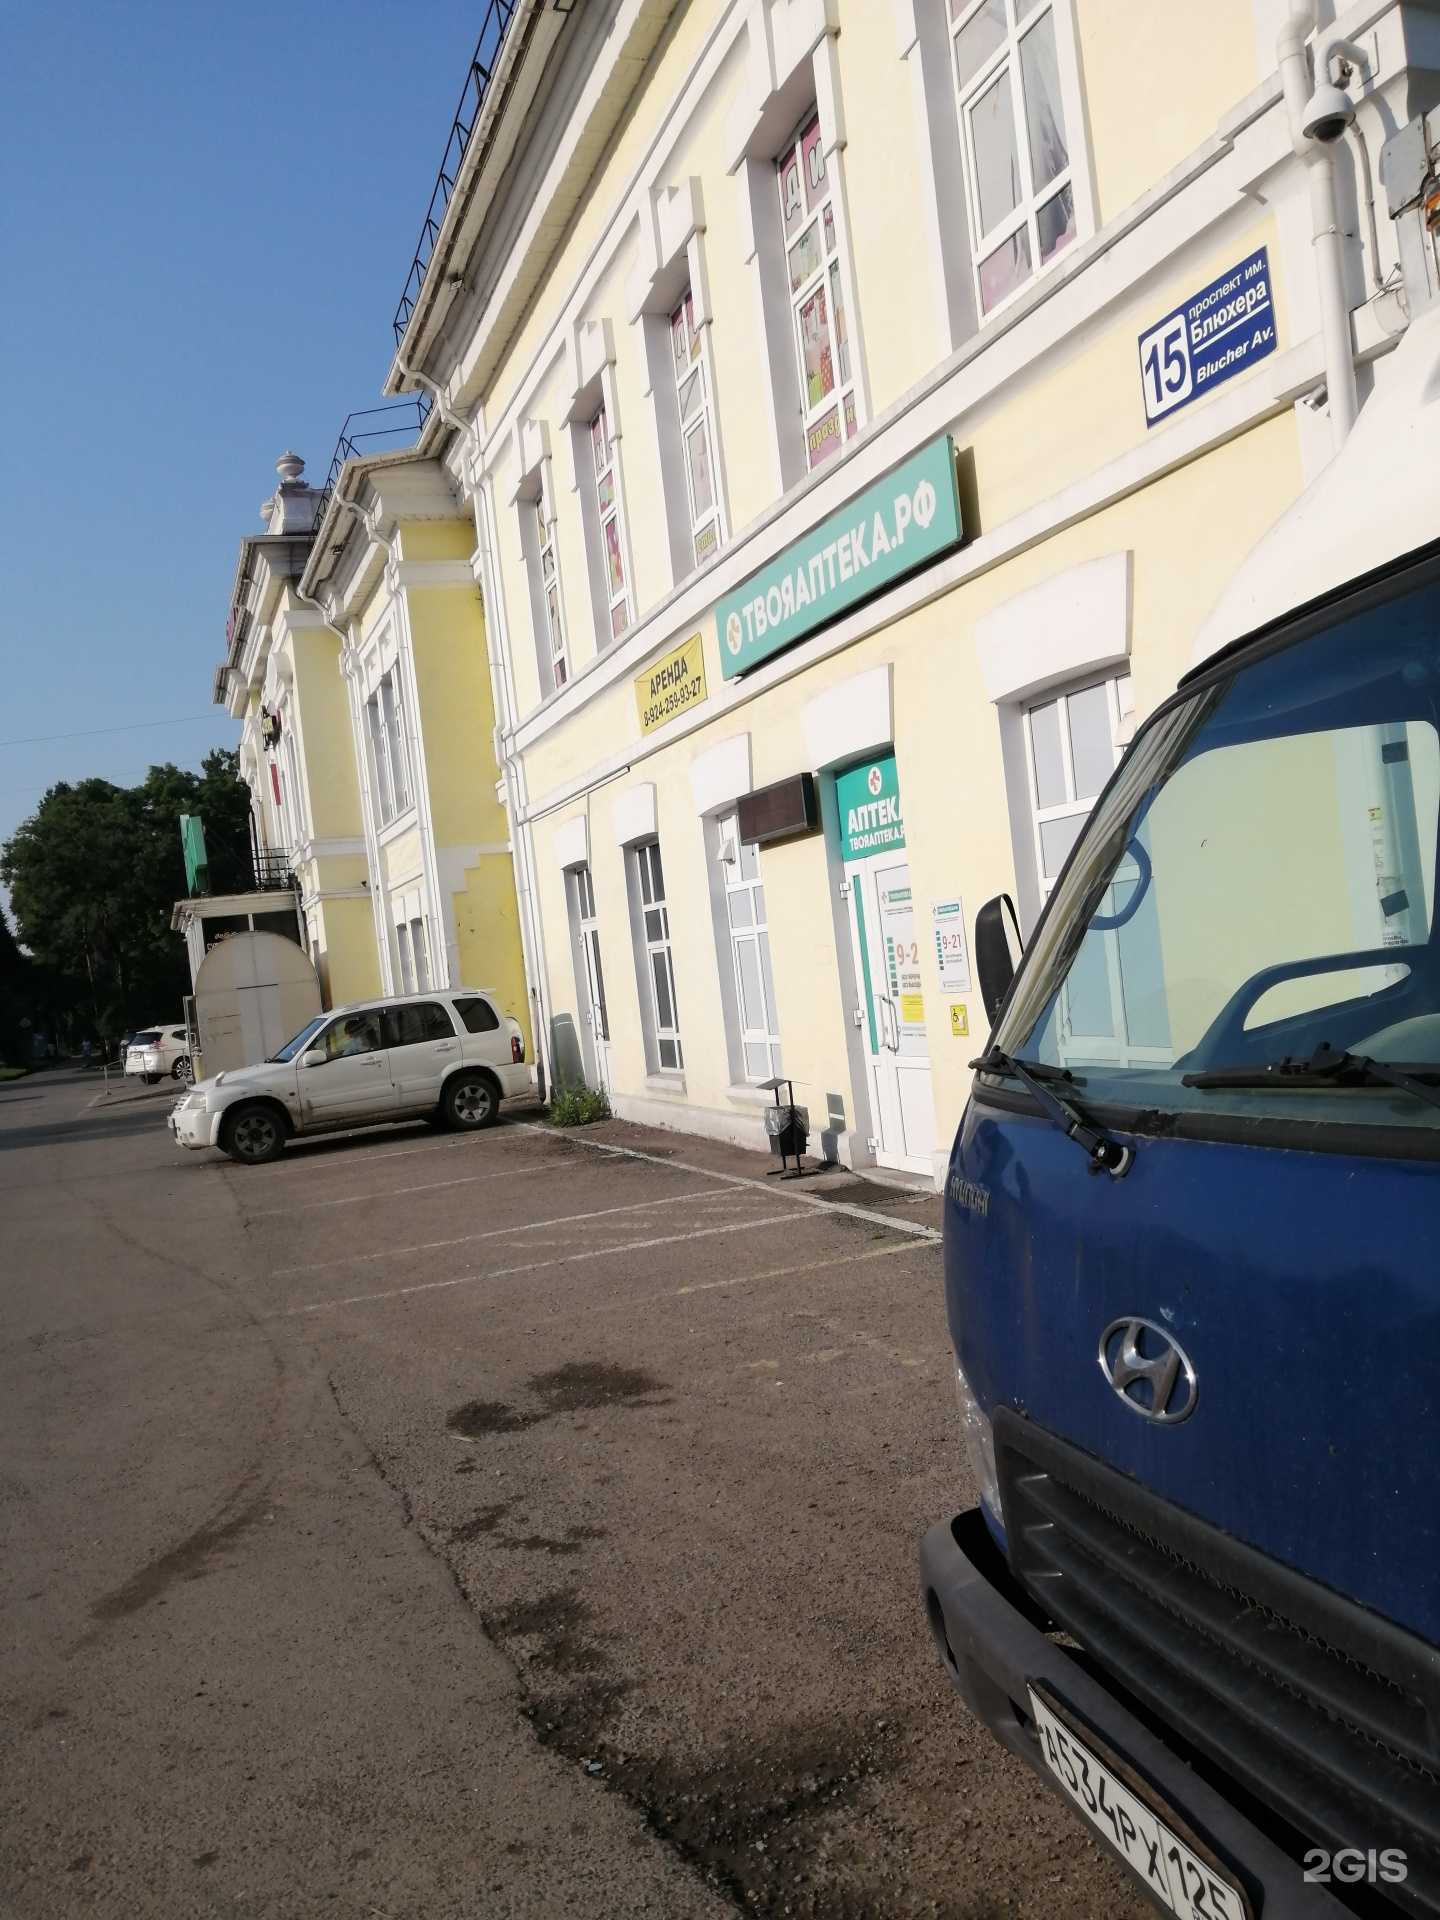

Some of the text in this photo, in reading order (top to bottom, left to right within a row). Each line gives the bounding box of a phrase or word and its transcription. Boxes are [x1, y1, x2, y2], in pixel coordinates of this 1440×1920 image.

[1188, 258, 1267, 320] проспект им.
[1190, 280, 1268, 345] Блюхера
[1144, 327, 1187, 404] 15
[1196, 325, 1275, 384] Blucher Av.
[741, 479, 937, 642] ТВОЯАПТЕКА.РФ
[650, 656, 689, 699] АРЕНДА
[848, 796, 901, 835] АПТЕК
